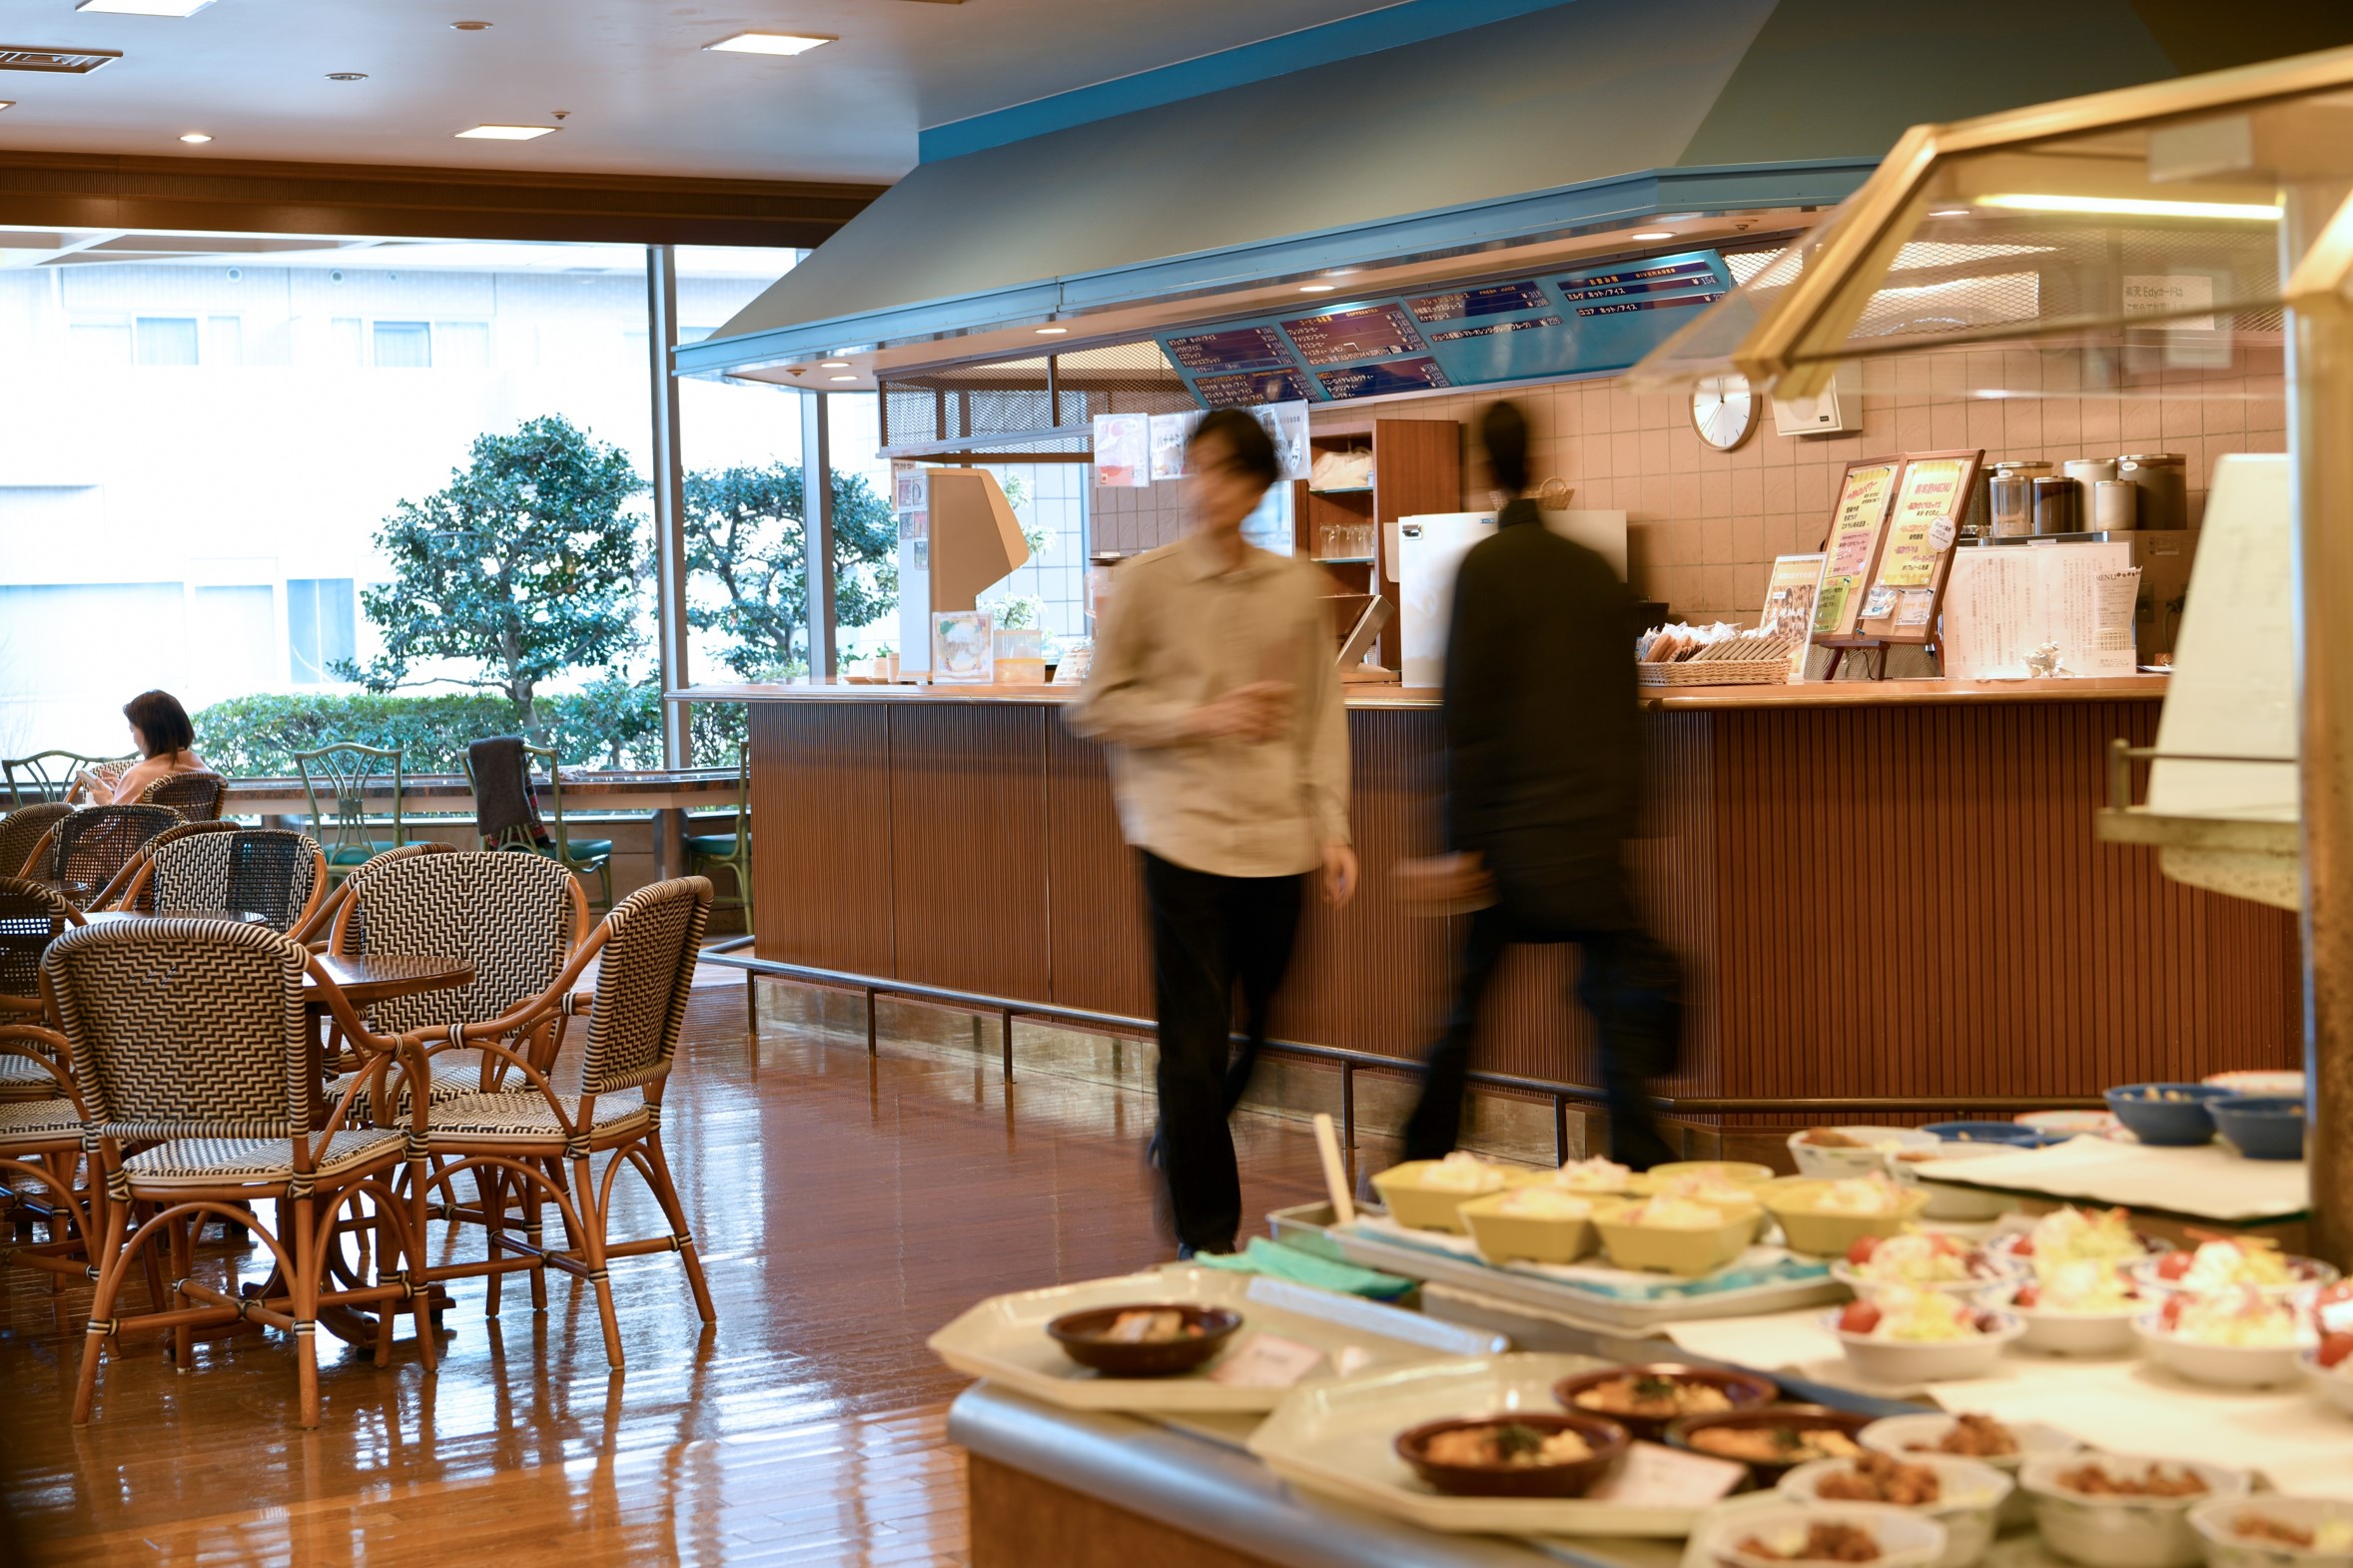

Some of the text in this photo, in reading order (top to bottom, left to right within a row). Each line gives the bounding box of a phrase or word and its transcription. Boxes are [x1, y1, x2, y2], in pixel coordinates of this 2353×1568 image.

[1422, 293, 1470, 305] フレッシュジュース
[1567, 292, 1585, 301] ミルク
[1587, 288, 1626, 299] ホット/アイス
[1600, 304, 1638, 314] ホット/アイス
[1419, 313, 1451, 322] バナナジュース
[1287, 327, 1318, 336] ブレンドコーヒー
[1190, 335, 1217, 344] ホット/アイス
[1292, 333, 1328, 344] アメリカンコーヒー
[1297, 342, 1325, 351] アイスコーヒー
